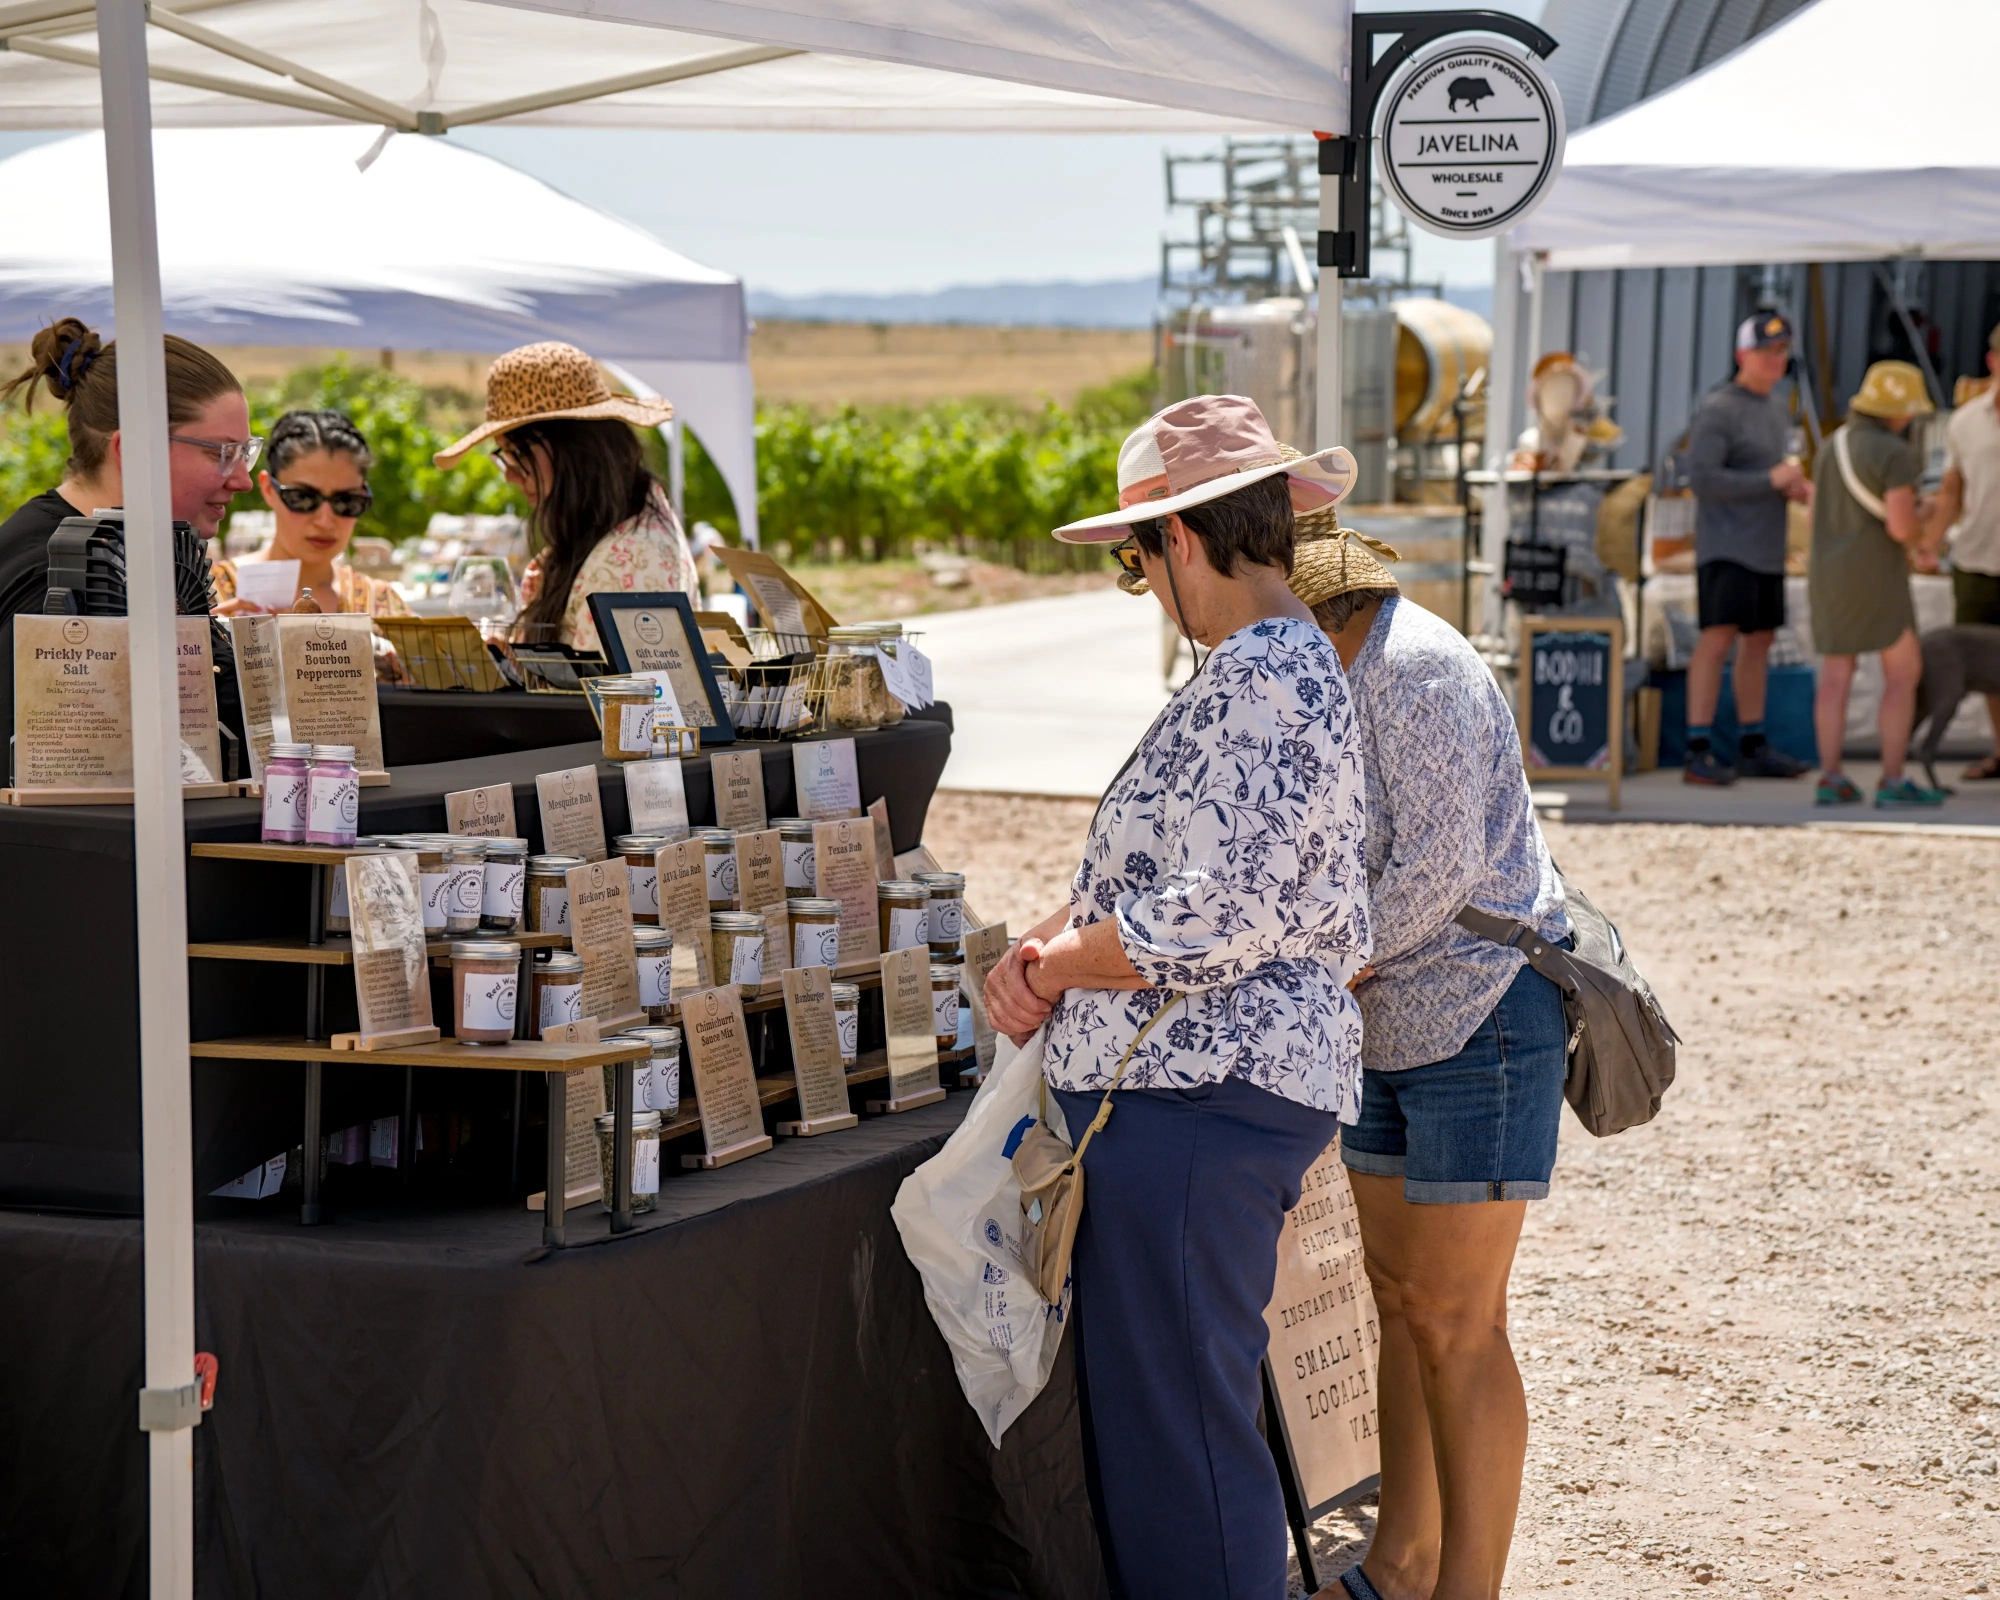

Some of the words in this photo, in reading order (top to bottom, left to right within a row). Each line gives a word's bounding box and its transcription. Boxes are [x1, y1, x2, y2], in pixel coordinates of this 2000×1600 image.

[1407, 66, 1446, 100] PREMIUM
[1447, 58, 1491, 68] QUALITY
[1492, 61, 1534, 98] PRODUCTS
[1417, 133, 1519, 156] JAVELINA
[1432, 172, 1503, 183] WHOLESALE
[1440, 206, 1469, 219] SINCE
[183, 644, 203, 656] Salt
[243, 643, 271, 657] Applewood
[305, 640, 348, 652] Smoked
[35, 648, 83, 663] Prickly
[86, 648, 117, 661] Pear
[305, 654, 351, 666] Bourbon
[635, 649, 653, 659] Gift
[654, 649, 680, 658] Cards
[63, 663, 90, 675] Salt
[243, 659, 263, 671] Smoked
[262, 657, 274, 669] Salt
[641, 660, 683, 670] Available
[296, 668, 362, 682] Peppercorns
[64, 687, 90, 695] Prickly
[1557, 685, 1575, 711] &
[636, 717, 646, 740] Sweet
[818, 766, 835, 777] Jerk
[727, 776, 751, 788] Javelina
[283, 781, 304, 804] Prickly
[329, 783, 349, 806] Prickly
[644, 785, 669, 799] Mojave
[732, 788, 749, 800] Hatch
[548, 796, 579, 812] Mesquite
[579, 792, 593, 804] Rub
[644, 798, 672, 811] Mustard
[459, 819, 482, 831] Sweet
[482, 812, 506, 827] Maple
[794, 847, 814, 865] Javelin
[827, 844, 849, 857] Texas
[849, 842, 863, 854] Rub
[690, 864, 701, 876] Rub
[711, 858, 732, 879] Mojave
[752, 869, 770, 881] Honey
[449, 868, 483, 891] Applewood
[499, 870, 523, 893] Smoked
[642, 875, 657, 889] Mes
[578, 889, 606, 905] Hickory
[606, 885, 620, 897] Rub
[557, 901, 569, 925] Sweet
[936, 902, 951, 913] Five
[816, 928, 835, 940] Texas
[981, 951, 996, 962] Herbs
[897, 973, 918, 985] Basque
[485, 982, 501, 1000] Red
[563, 988, 582, 1006] Hicko
[794, 991, 825, 1004] Hamburger
[897, 985, 919, 998] Chorizo
[935, 994, 954, 1013] Basque
[695, 1012, 735, 1034] Chimichurri
[838, 1012, 858, 1028] Hamb
[701, 1031, 721, 1047] Sauce
[721, 1027, 735, 1039] Mix
[1314, 1161, 1347, 1188] BLEN
[1290, 1196, 1334, 1229] BAKING
[1301, 1225, 1340, 1255] SAUCE
[1317, 1256, 1341, 1281] DIP
[1281, 1289, 1335, 1328] INSTANT
[1337, 1275, 1372, 1304] MEALS
[1294, 1335, 1351, 1380] SMALL
[1353, 1319, 1378, 1353] BAT
[1305, 1368, 1370, 1420] LOCALY
